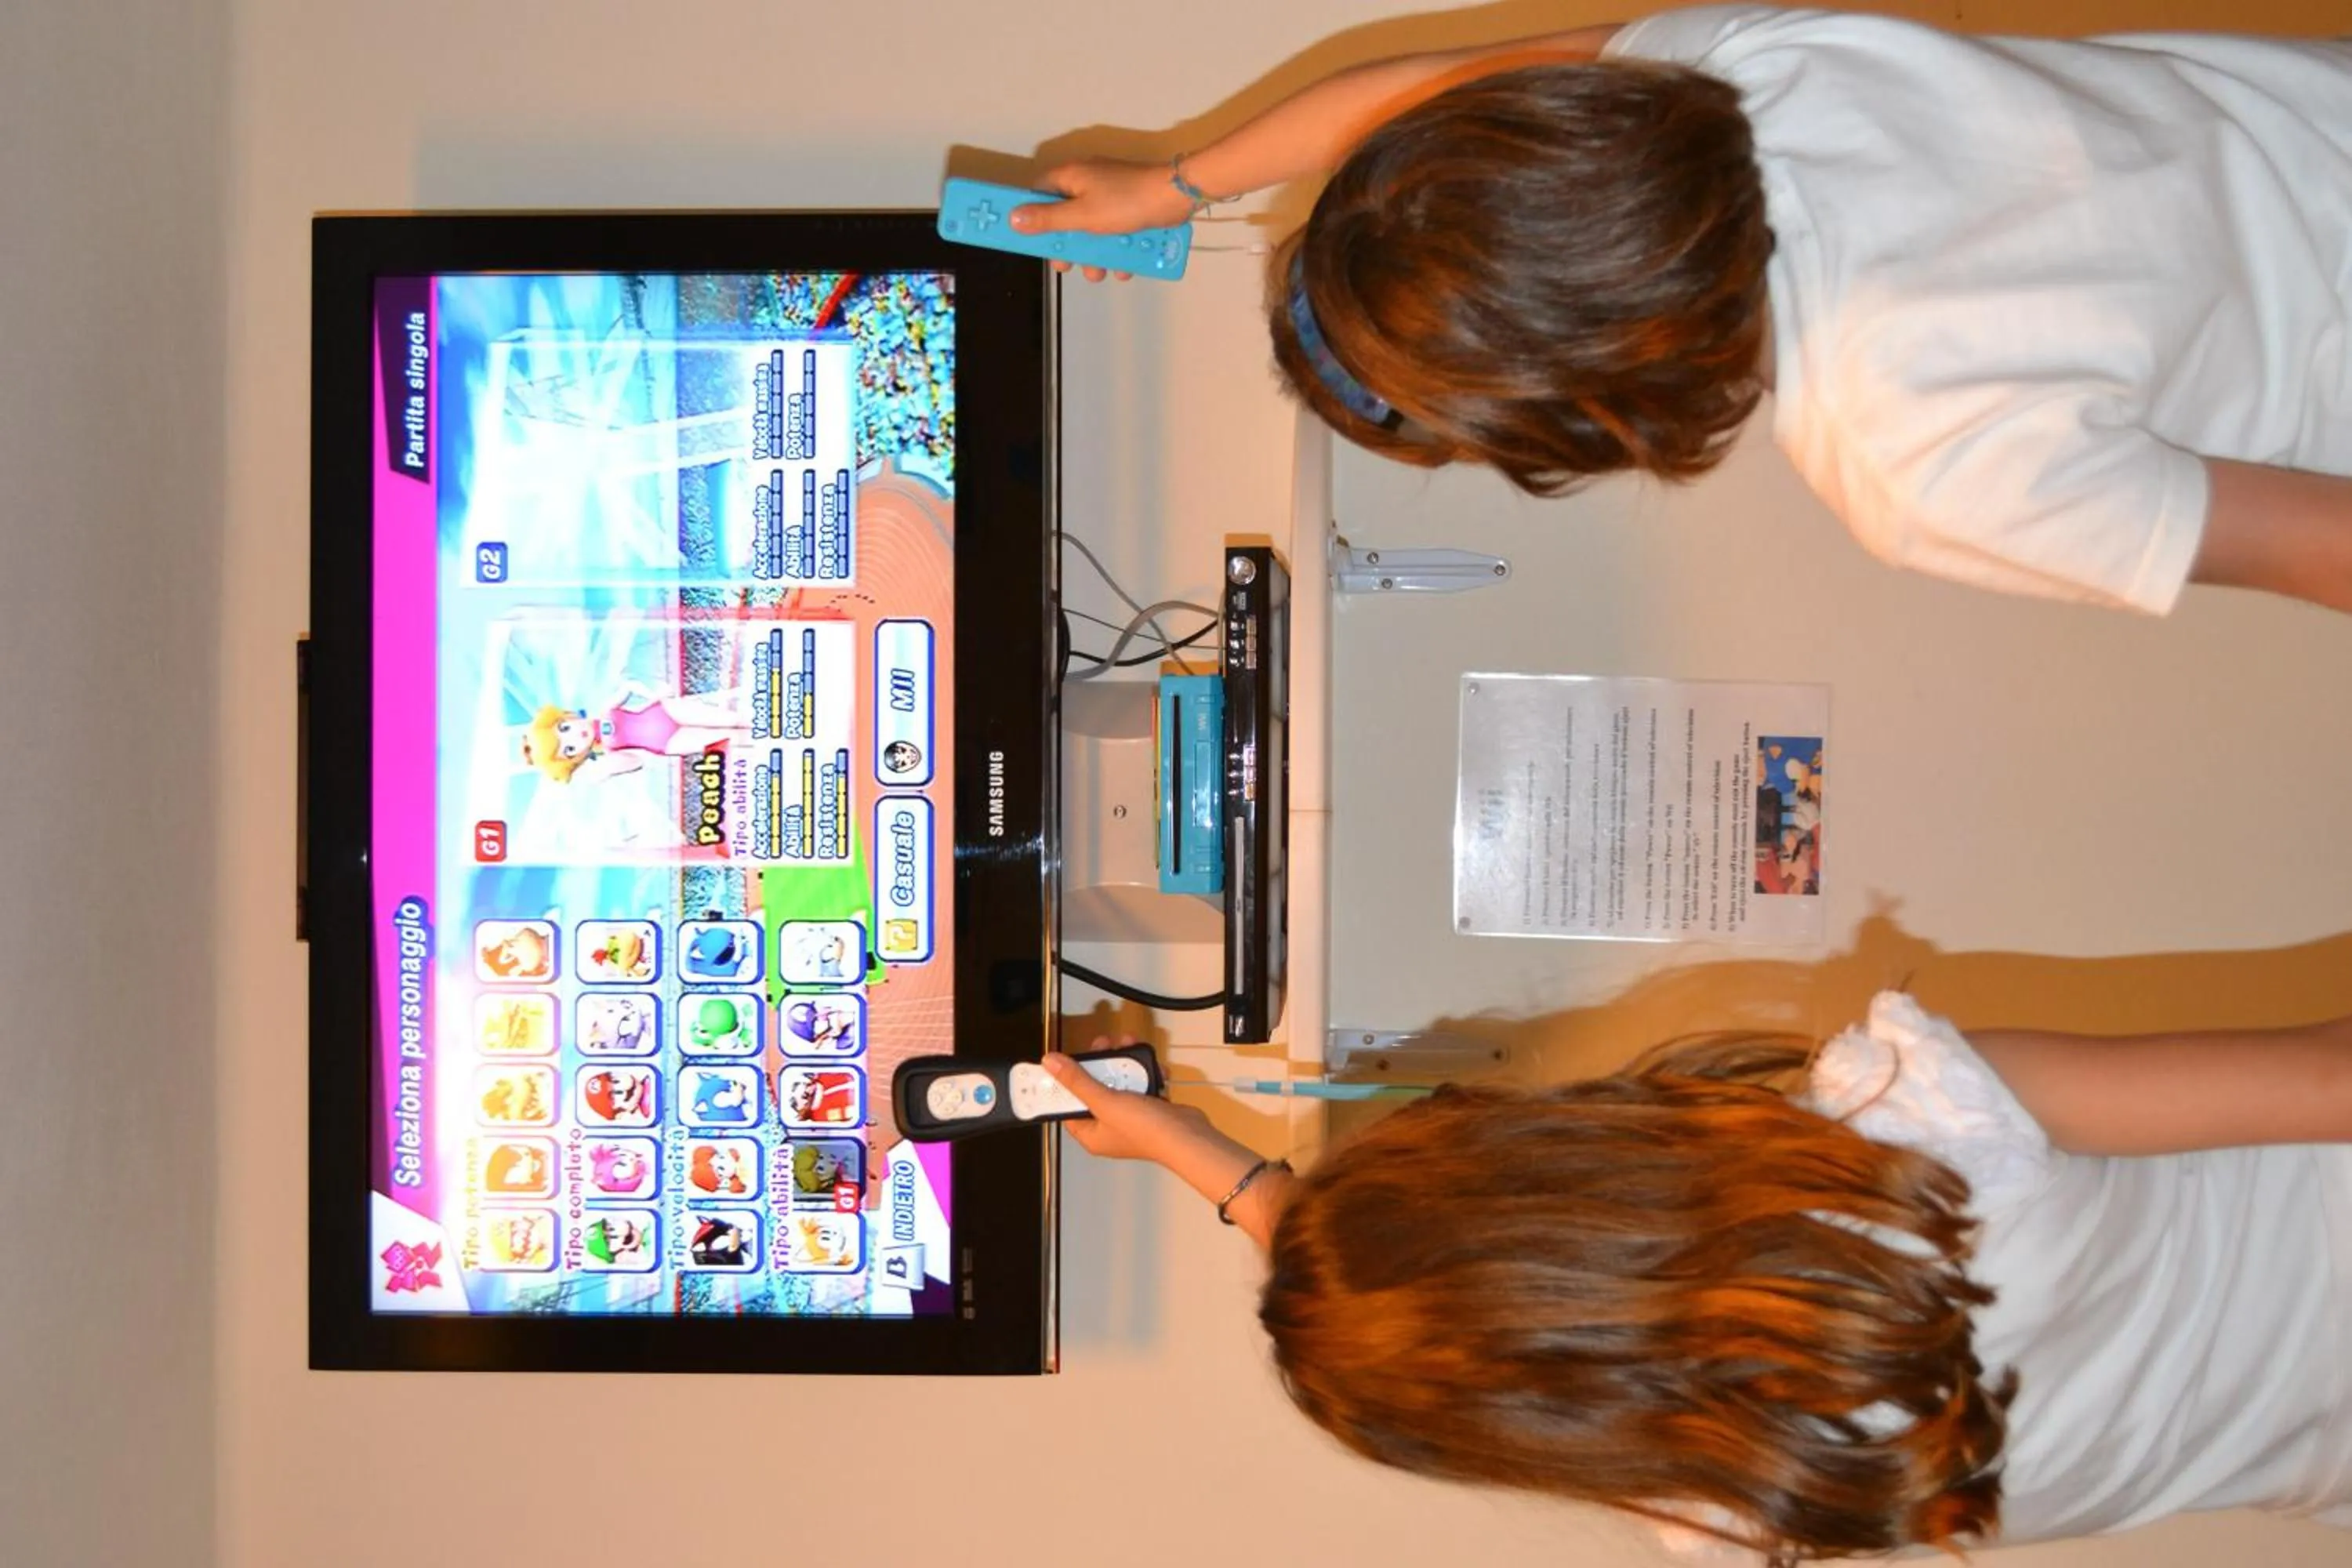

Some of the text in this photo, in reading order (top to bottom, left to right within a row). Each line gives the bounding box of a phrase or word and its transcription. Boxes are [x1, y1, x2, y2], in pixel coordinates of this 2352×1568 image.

[405, 312, 429, 468] Partita singola
[786, 392, 802, 460] Potenza
[479, 548, 501, 580] G2
[752, 485, 769, 580] Accelerazione
[818, 484, 835, 579] Resistenza
[785, 672, 801, 739] Potenza
[692, 751, 724, 845] Peach
[732, 758, 749, 856] Tipo abilità
[752, 764, 769, 858] Accelerazione
[818, 763, 835, 858] Resistenza
[989, 750, 1004, 837] SAMSUNG
[479, 826, 500, 857] G1
[890, 810, 915, 906] Casuale
[394, 902, 426, 1187] Seleziona personaggio
[564, 1127, 584, 1270] Tipo completo
[667, 1130, 687, 1269] Tipo velocità
[771, 1148, 791, 1269] Tipo abilità
[837, 1185, 854, 1210] G1
[886, 1160, 915, 1279] B INDIETRO
[461, 1226, 481, 1269] Tipo
